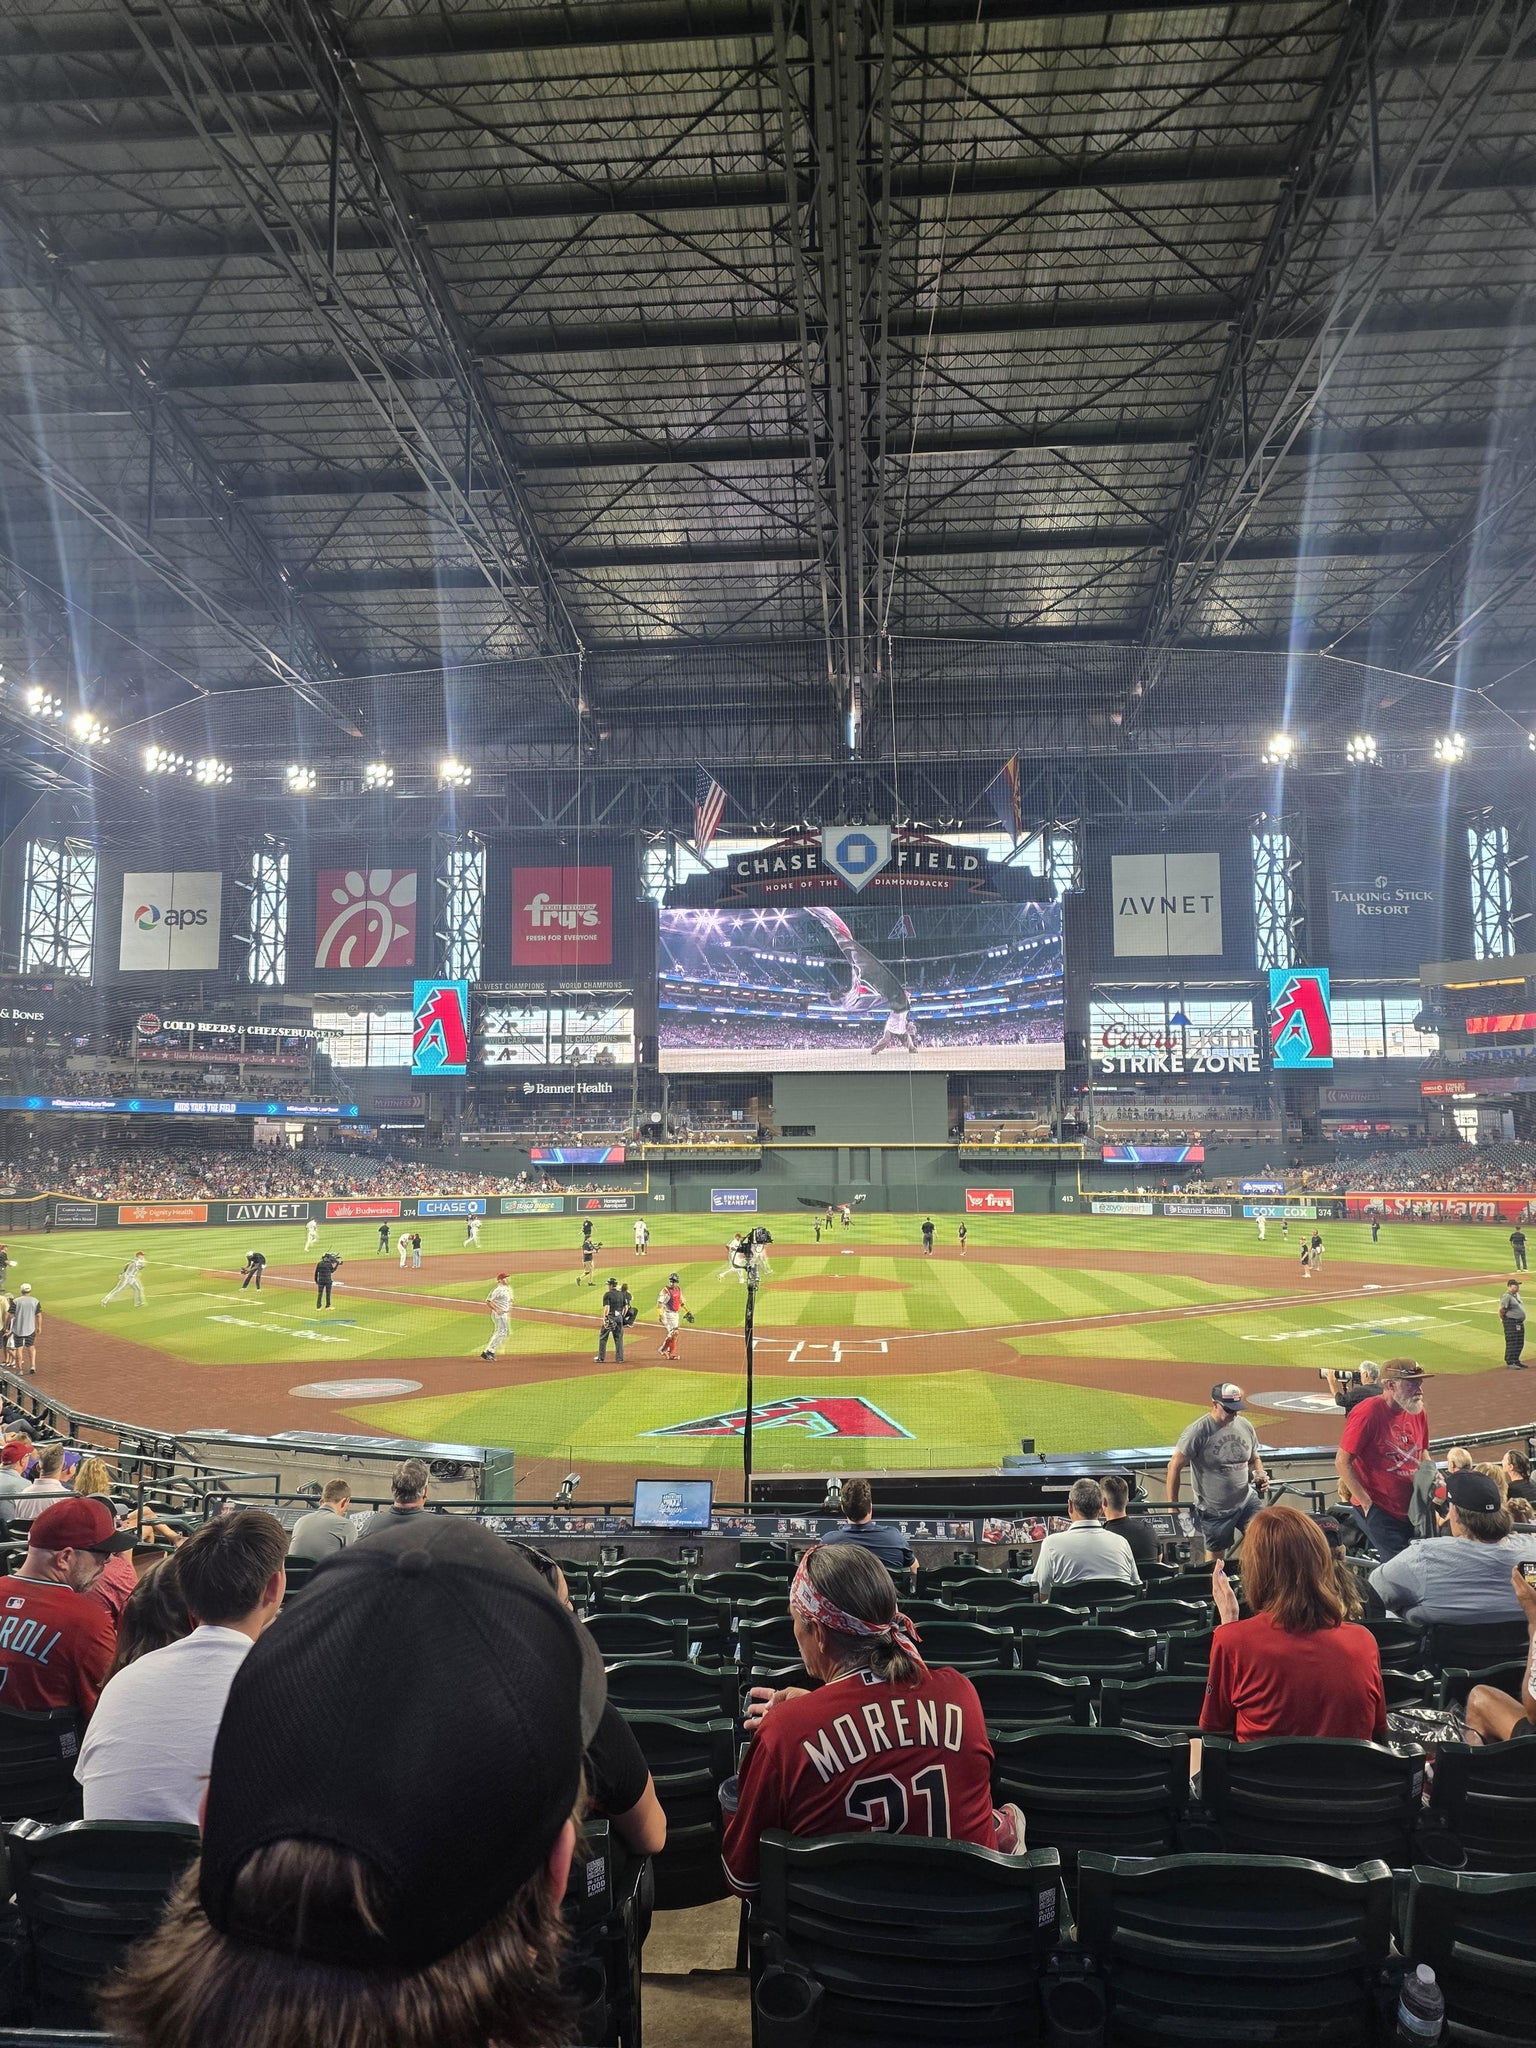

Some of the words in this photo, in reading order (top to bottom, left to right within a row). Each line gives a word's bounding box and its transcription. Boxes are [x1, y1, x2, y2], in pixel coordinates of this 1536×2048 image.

[737, 853, 817, 877] CHASE
[898, 851, 979, 871] FIELD
[766, 883, 793, 892] HOME
[819, 879, 838, 887] THE
[874, 878, 950, 888] DIAMONDBACKS
[1331, 890, 1391, 902] TALKING
[1395, 889, 1433, 901] STICK
[523, 893, 598, 929] fry's
[1119, 896, 1214, 915] AVNET
[1356, 903, 1410, 915] RESORT
[164, 909, 208, 930] aps
[12, 1009, 45, 1021] BONES
[163, 1020, 195, 1031] COLD
[197, 1023, 236, 1034] BEERS
[237, 1025, 246, 1034] &
[247, 1026, 344, 1039] CHEESEBURGERS
[1101, 1022, 1178, 1049] Coors
[1185, 1028, 1259, 1049] LIGHT
[507, 1036, 527, 1044] CARD
[575, 1035, 618, 1043] CHAMPIONS
[1102, 1054, 1184, 1073] STRIKE
[1192, 1053, 1261, 1073] ZONE
[536, 1083, 575, 1094] Banner
[576, 1082, 613, 1093] Health
[174, 1102, 189, 1111] KIDS
[190, 1103, 206, 1112] TAKE
[207, 1103, 218, 1112] THE
[219, 1103, 236, 1113] FIELD
[985, 1193, 1012, 1207] fry's
[149, 1208, 171, 1217] Dignity
[172, 1208, 193, 1216] Health
[236, 1204, 301, 1219] AVNET
[355, 1206, 394, 1215] Budweiser
[403, 1209, 416, 1217] 374
[426, 1202, 466, 1213] CHASE
[1176, 1205, 1202, 1214] Banner
[1203, 1205, 1227, 1215] Health
[1252, 1207, 1276, 1216] COX
[1284, 1207, 1308, 1216] COX
[1318, 1208, 1332, 1216] 374
[1394, 1199, 1444, 1215] State
[1446, 1199, 1496, 1217] Farm
[0, 1615, 62, 1665] ROLL
[803, 1699, 963, 1784] MORENO
[587, 1880, 606, 1893] FOOD
[1039, 1911, 1056, 1922] FOOD
